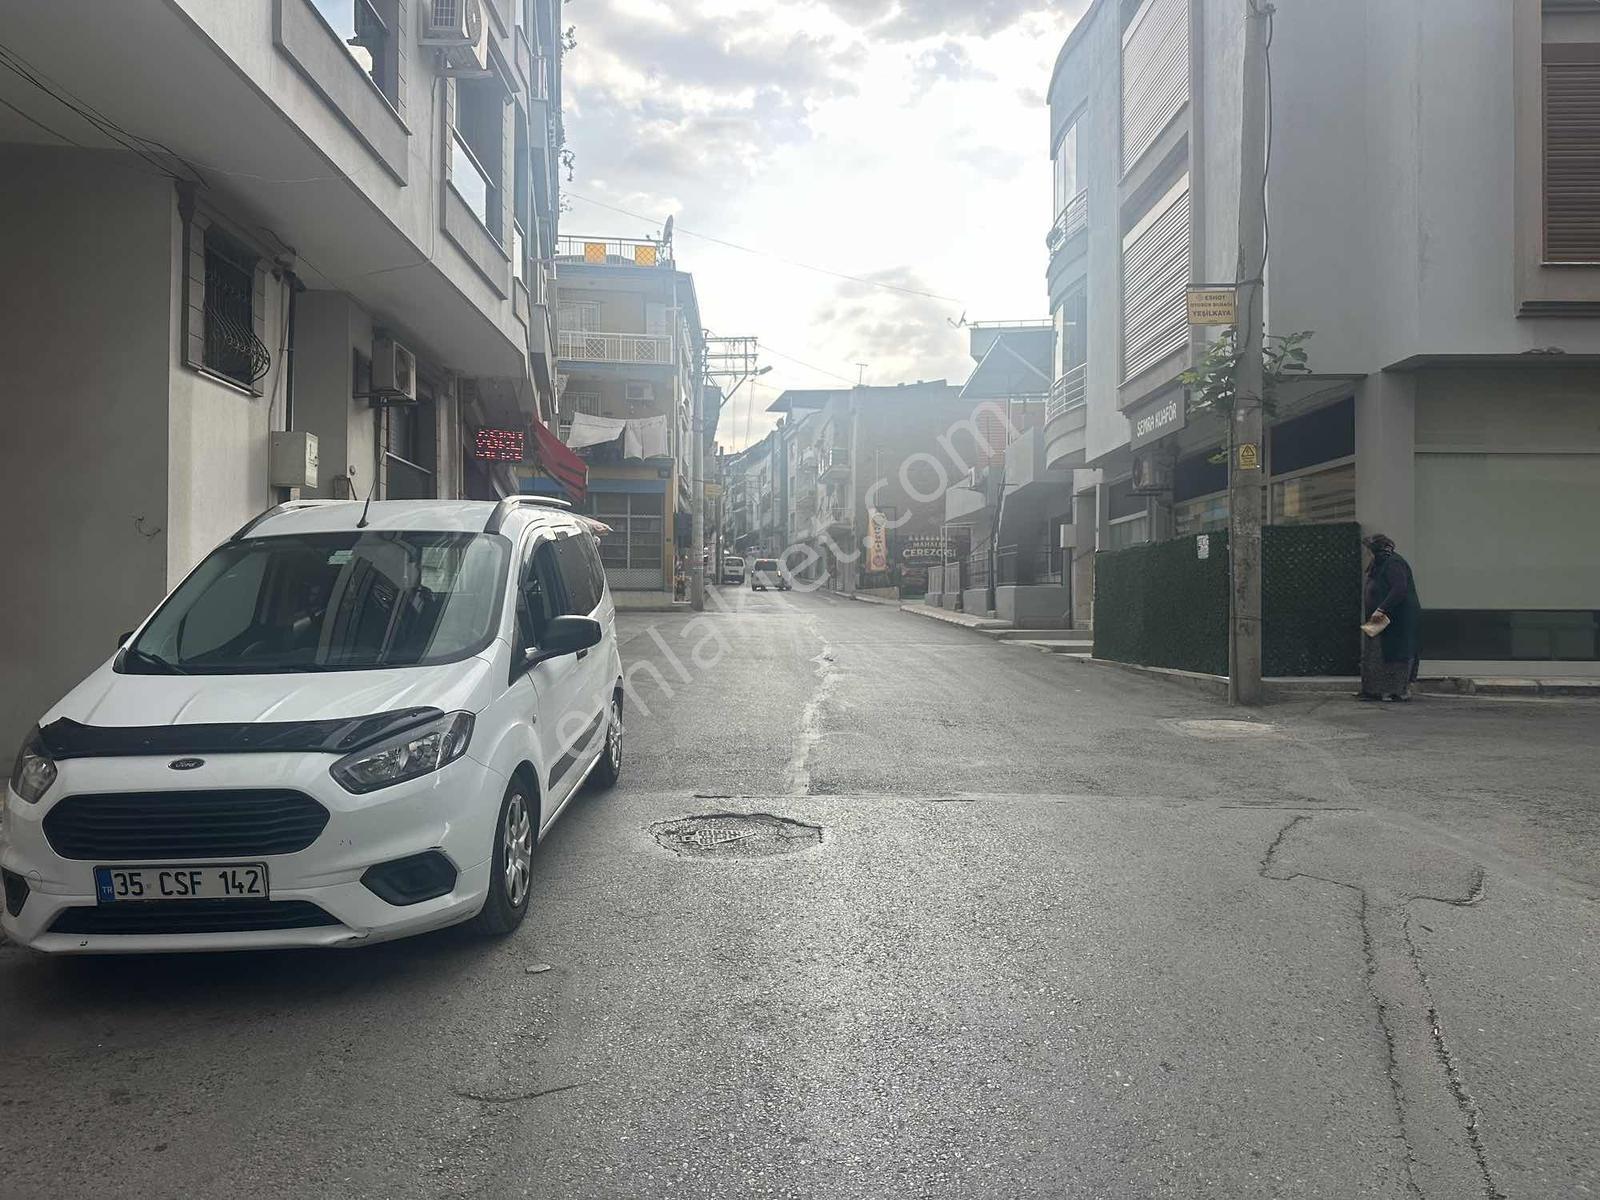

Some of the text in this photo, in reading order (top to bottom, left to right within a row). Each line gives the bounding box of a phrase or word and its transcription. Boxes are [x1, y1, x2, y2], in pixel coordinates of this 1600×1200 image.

[1136, 400, 1177, 438] SEMRA KUAFÖR
[102, 886, 113, 895] TR
[114, 869, 260, 896] 35 CSF 142
